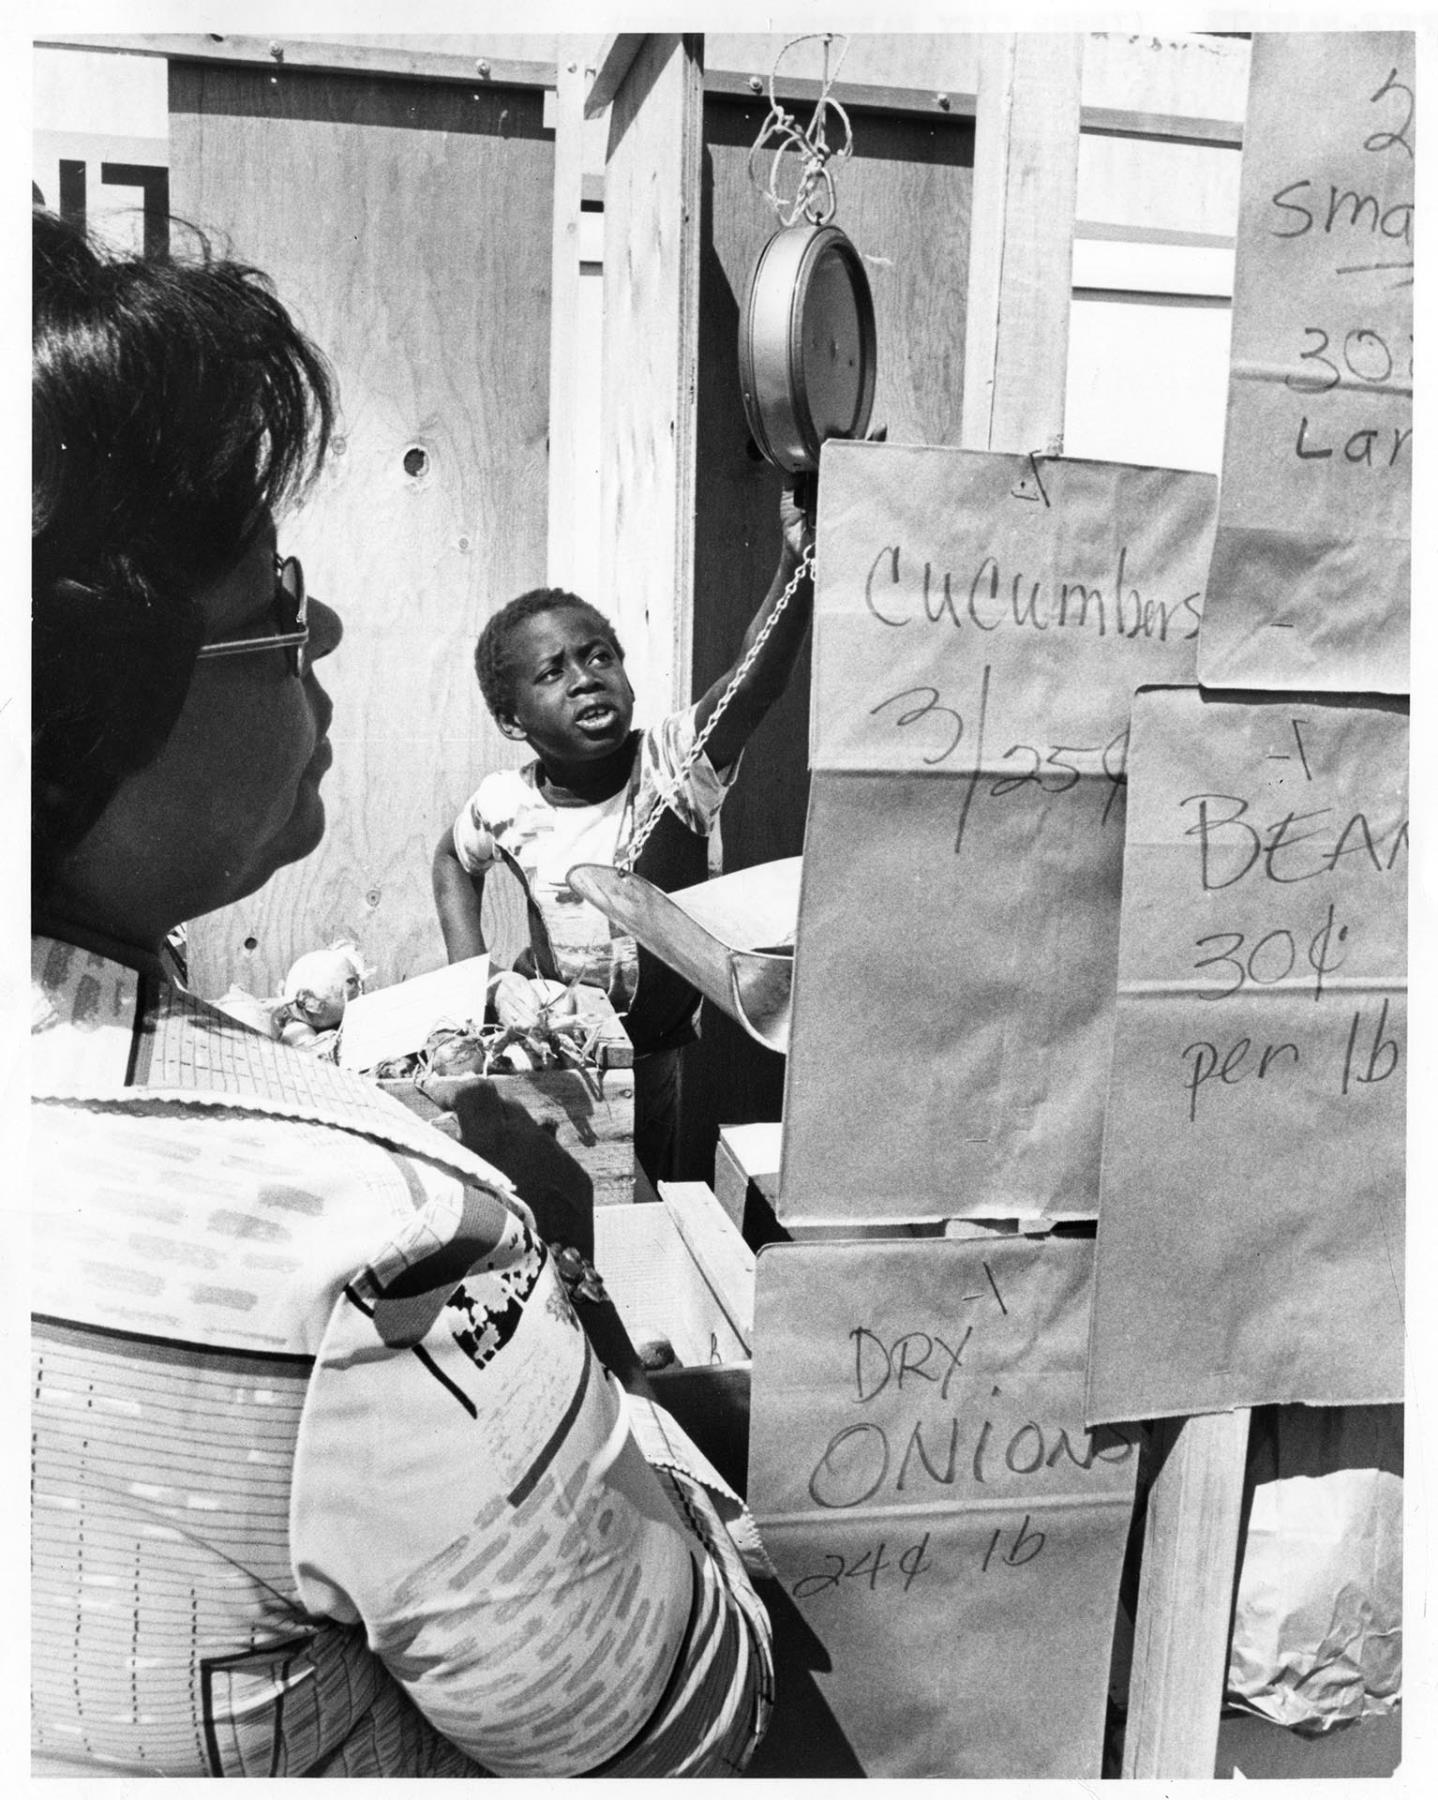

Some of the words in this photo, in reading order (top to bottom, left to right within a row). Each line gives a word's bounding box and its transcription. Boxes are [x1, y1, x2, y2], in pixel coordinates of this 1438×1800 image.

[1285, 327, 1413, 394] 30
[1182, 1038, 1299, 1122] per
[850, 1326, 973, 1404] DRY
[793, 1532, 932, 1598] 24¢
